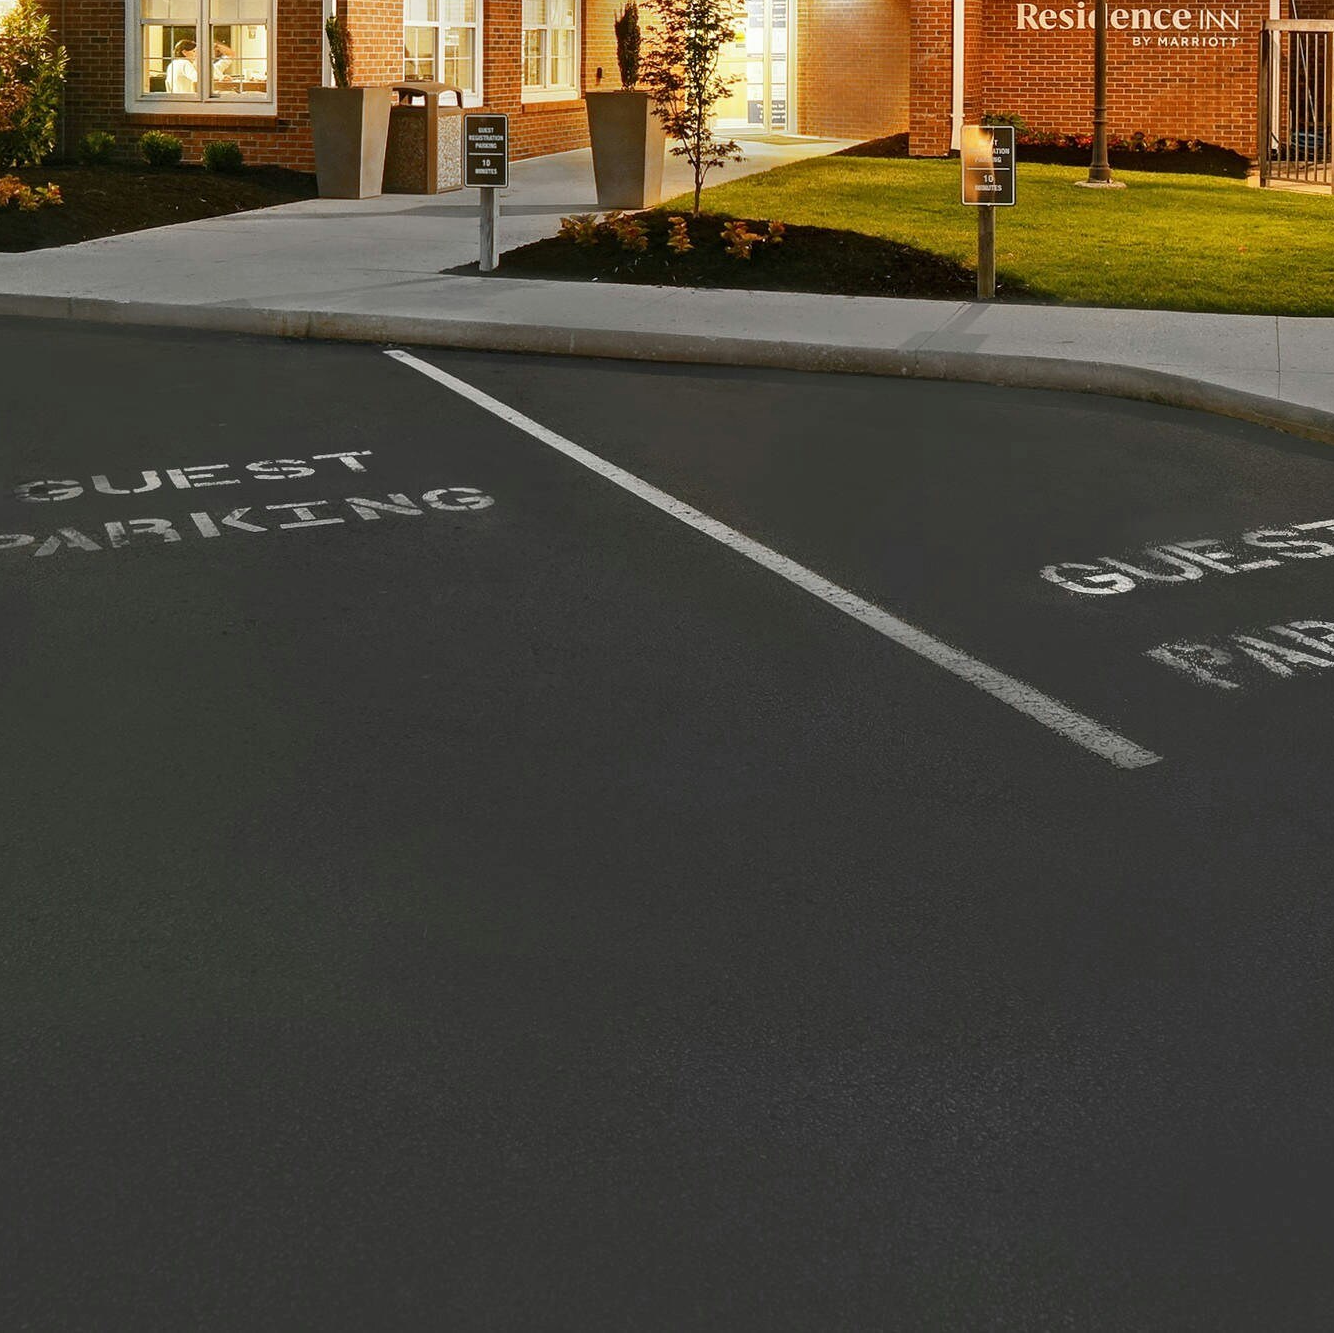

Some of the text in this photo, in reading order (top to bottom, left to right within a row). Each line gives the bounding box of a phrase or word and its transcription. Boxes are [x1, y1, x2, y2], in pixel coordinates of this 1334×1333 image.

[1200, 9, 1239, 30] INN
[1132, 36, 1239, 47] BY MARRIOTT
[482, 159, 491, 167] 10
[983, 174, 994, 183] 10
[12, 449, 373, 502] GUEST
